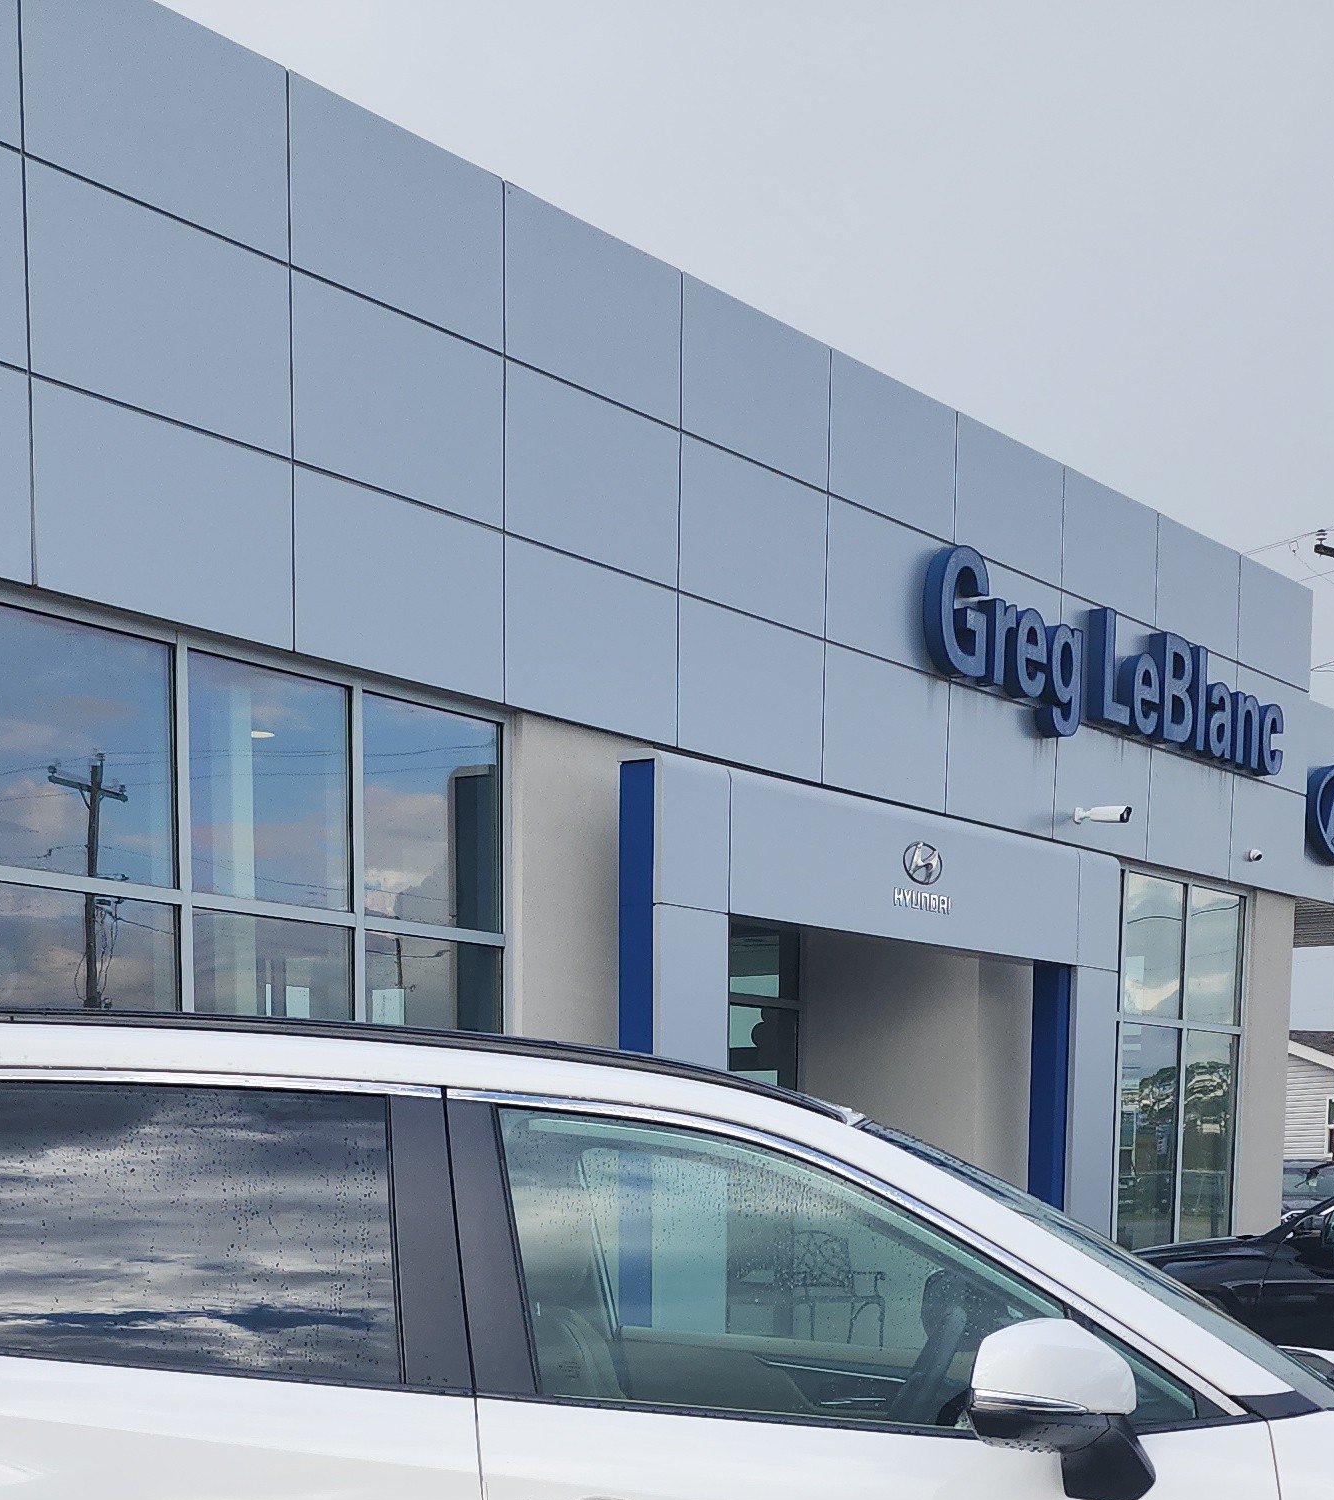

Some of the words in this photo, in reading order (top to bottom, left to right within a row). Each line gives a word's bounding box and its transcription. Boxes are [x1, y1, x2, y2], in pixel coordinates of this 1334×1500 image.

[924, 545, 1083, 737] Greg
[1088, 606, 1284, 775] LeBlanc
[893, 886, 951, 915] HYUNDAI
